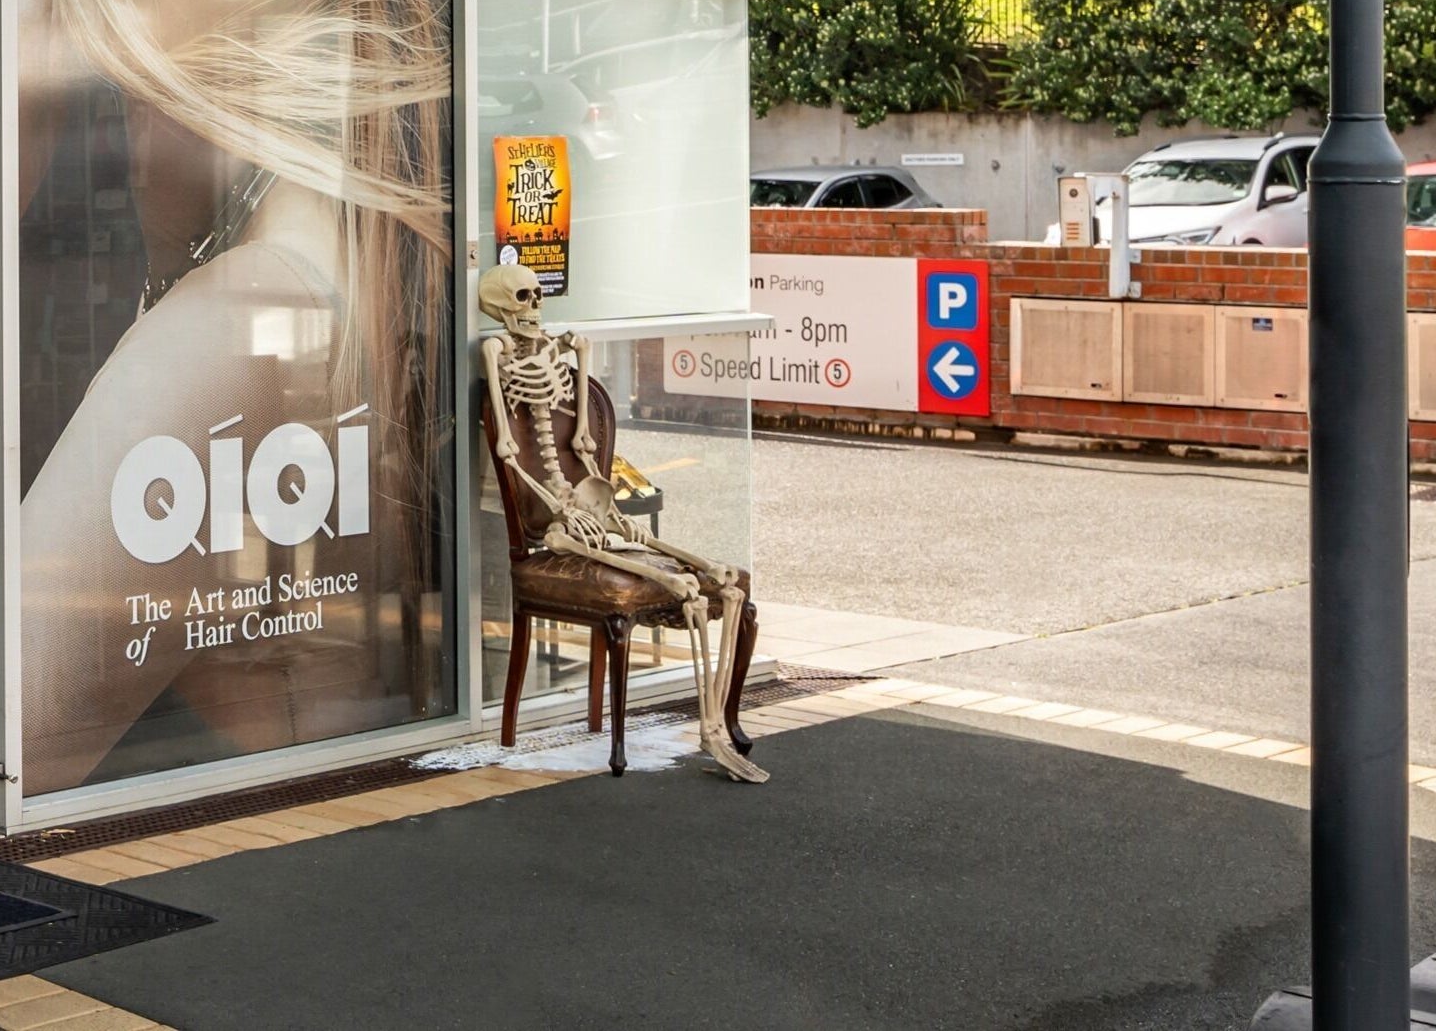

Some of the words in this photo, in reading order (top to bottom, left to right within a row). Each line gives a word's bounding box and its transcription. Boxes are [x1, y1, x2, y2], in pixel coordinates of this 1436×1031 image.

[509, 164, 555, 194] TRICK
[507, 197, 559, 227] TREAT
[524, 191, 542, 203] OR
[769, 275, 824, 296] Parking
[938, 282, 968, 320] P
[800, 316, 848, 348] 8pm
[699, 351, 762, 384] Speed
[769, 356, 821, 384] Limit
[125, 592, 173, 627] The
[183, 586, 225, 618] Art
[231, 575, 272, 611] and
[277, 570, 360, 604] Science
[125, 626, 152, 667] of
[183, 618, 234, 652] Hair
[241, 601, 324, 642] Control
